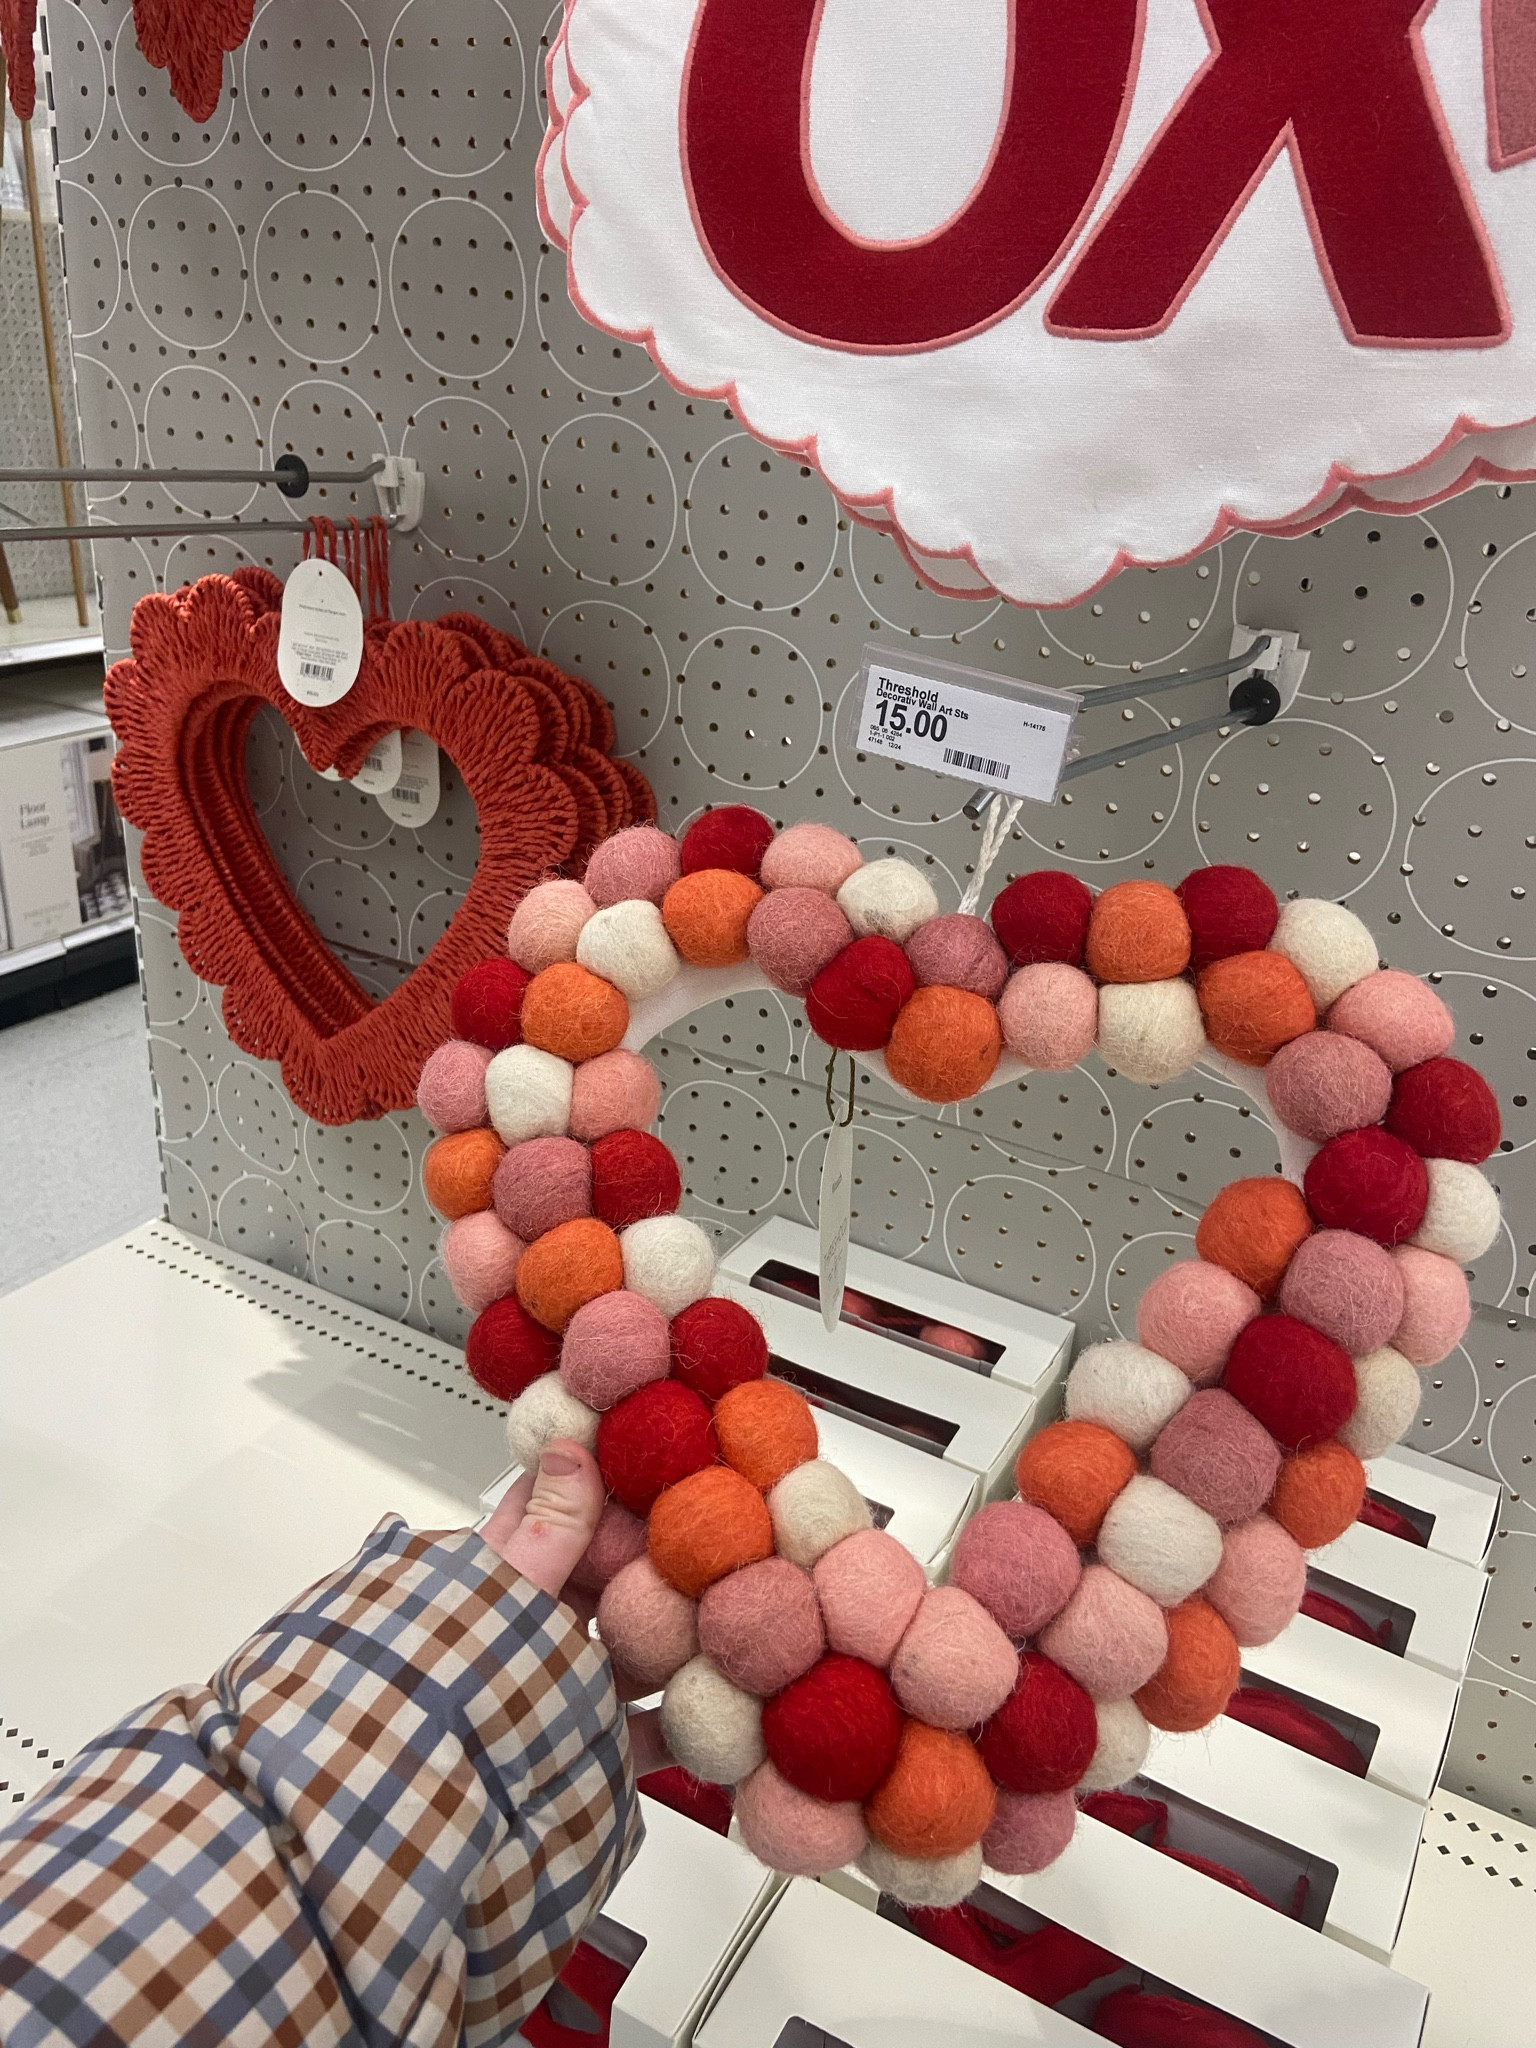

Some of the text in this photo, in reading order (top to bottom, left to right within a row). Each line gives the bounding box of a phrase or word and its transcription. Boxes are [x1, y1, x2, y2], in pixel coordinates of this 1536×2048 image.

[876, 688, 969, 720] Decorativ Wall Art Sts
[879, 677, 939, 703] Threshold
[875, 699, 948, 742] 15.00
